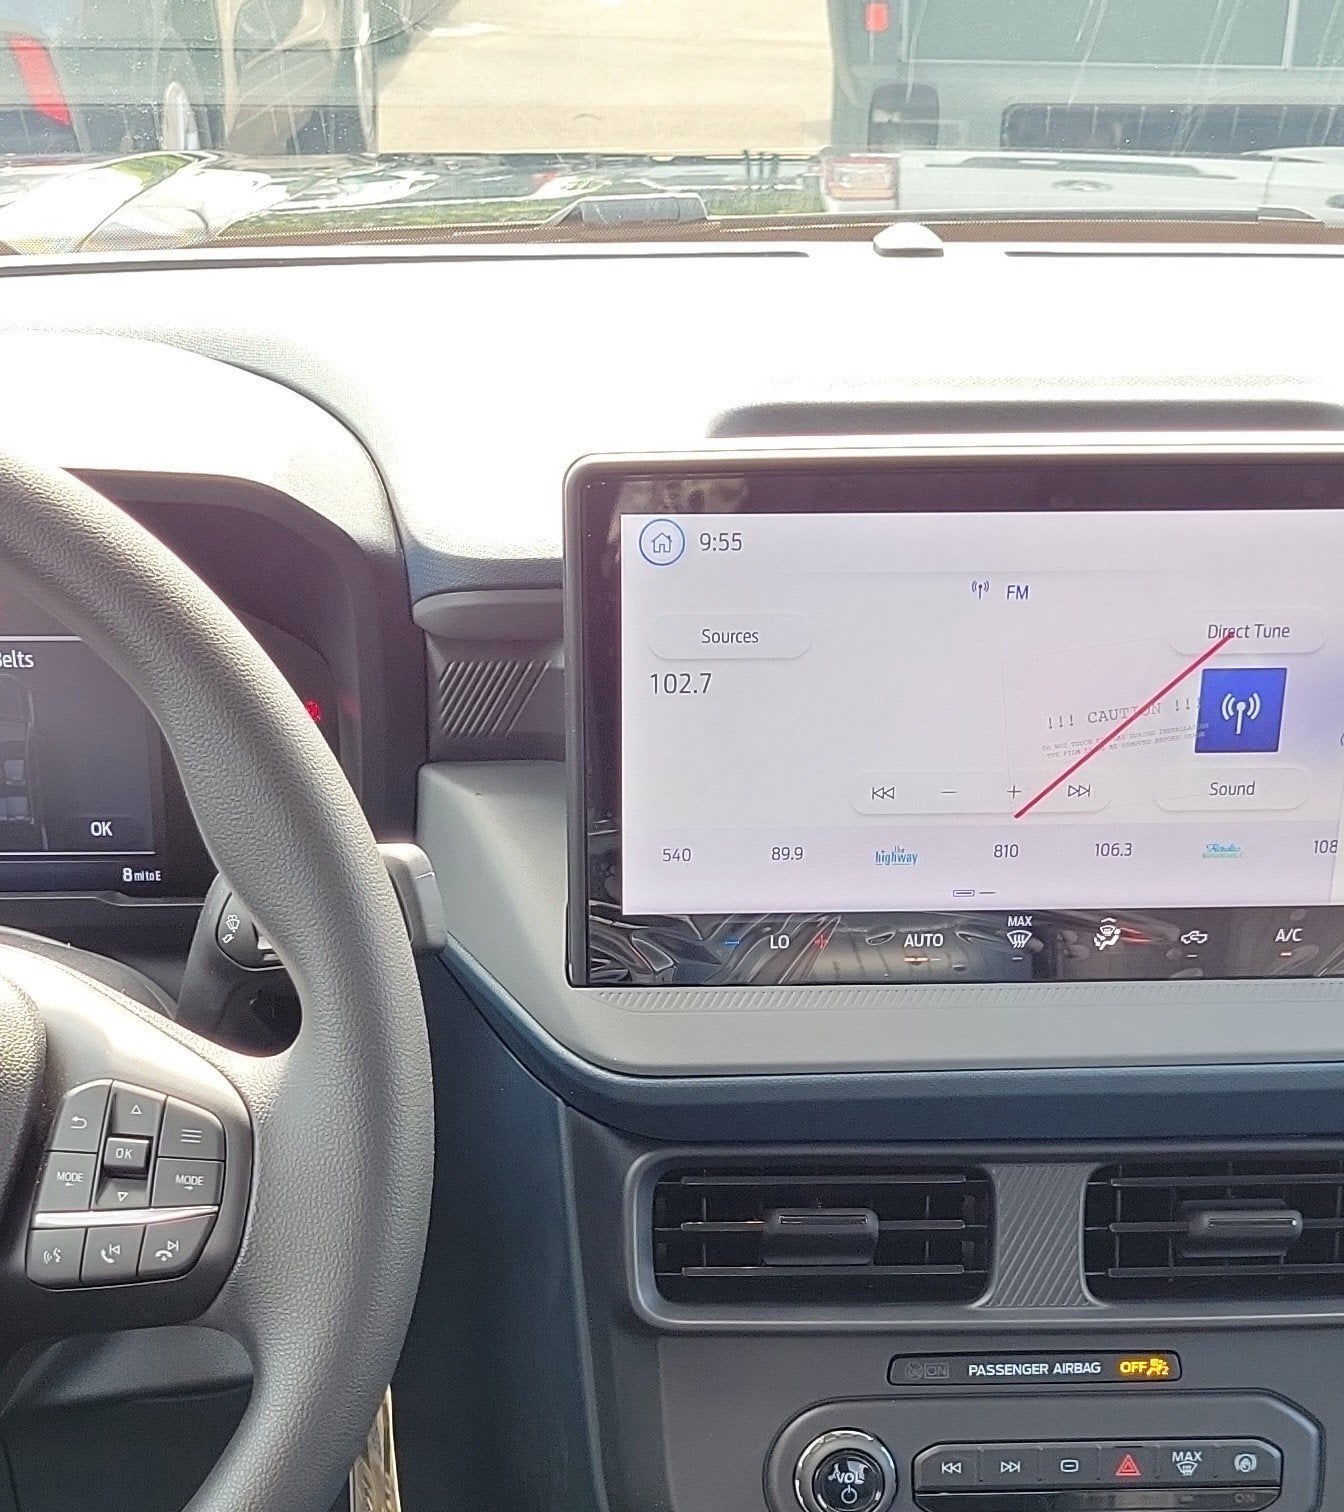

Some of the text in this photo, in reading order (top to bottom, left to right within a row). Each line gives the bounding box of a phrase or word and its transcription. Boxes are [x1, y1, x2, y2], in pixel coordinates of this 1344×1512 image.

[699, 532, 743, 552] 9:55
[1006, 584, 1029, 600] FM
[701, 628, 759, 644] Sources
[1207, 623, 1290, 640] Direct Tune
[649, 672, 712, 695] 102.7
[1209, 782, 1256, 797] Sound
[90, 821, 114, 837] OK
[662, 847, 692, 862] 540
[771, 846, 804, 861] 89.9
[993, 844, 1019, 858] 810
[1094, 843, 1132, 858] 106.3
[875, 850, 919, 867] highway
[1008, 915, 1033, 927] MAX
[769, 935, 790, 949] LO
[904, 933, 944, 948] AUTO
[1275, 928, 1303, 943] A/C
[115, 1147, 133, 1160] OK
[57, 1171, 85, 1183] MODE
[175, 1174, 205, 1186] MODE
[968, 1361, 1102, 1377] PASSENGER AIRBAG
[1119, 1361, 1147, 1374] OFF
[1171, 1451, 1203, 1462] MAX
[836, 1472, 864, 1485] VOL
